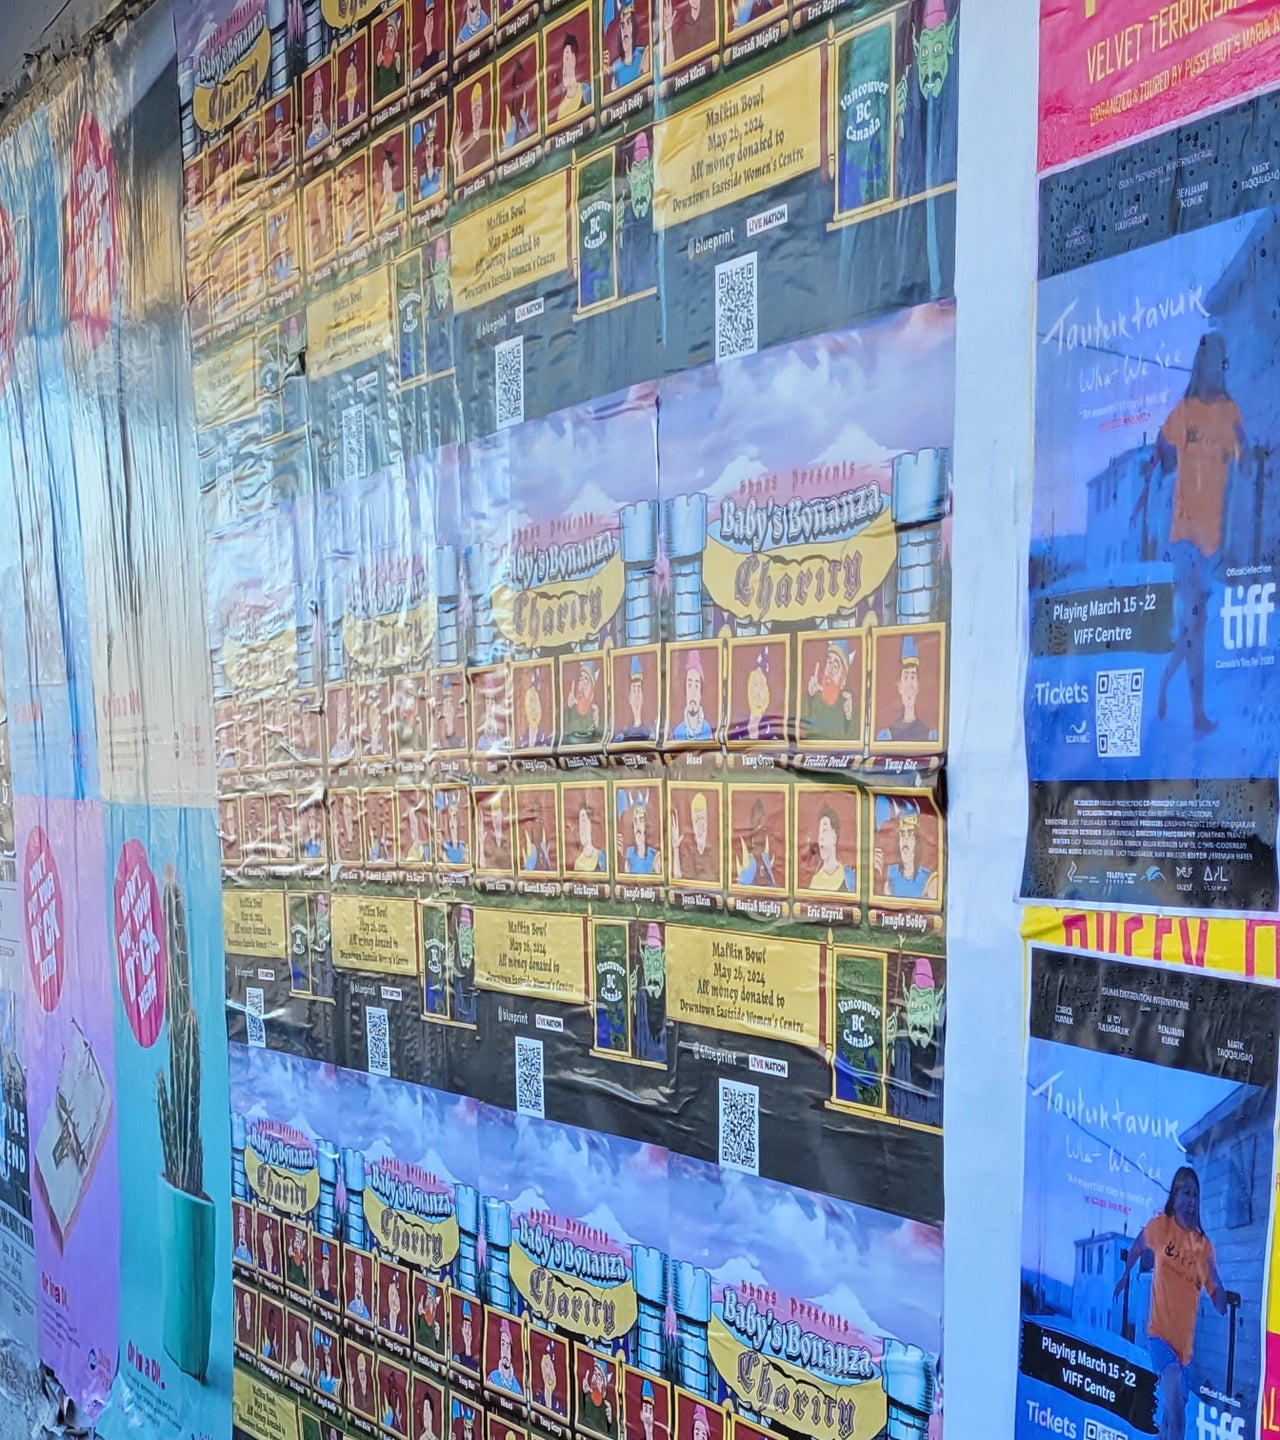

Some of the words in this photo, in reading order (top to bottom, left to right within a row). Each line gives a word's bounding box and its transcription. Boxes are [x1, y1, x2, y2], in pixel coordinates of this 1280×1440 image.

[1087, 24, 1143, 84] VELVET
[1139, 70, 1170, 102] TOURED
[1171, 67, 1183, 84] BY
[1185, 51, 1210, 77] PUSSY
[1221, 582, 1276, 650] tiff
[745, 947, 767, 964] Bowl
[713, 961, 731, 979] May
[749, 968, 766, 985] 2024
[712, 984, 739, 1003] money
[741, 988, 773, 1006] donated
[775, 992, 785, 1008] to
[837, 997, 881, 1019] Vancouver
[680, 998, 715, 1018] Downtown
[716, 1005, 744, 1022] Eastside
[746, 1010, 777, 1030] Women's
[779, 1016, 805, 1033] Centre
[851, 1015, 865, 1034] BC
[843, 1028, 874, 1049] Canada
[699, 1044, 737, 1066] blueprint
[764, 1059, 786, 1074] NATION
[723, 1287, 781, 1350] Baby's
[786, 1320, 872, 1378] Bonanza
[737, 1350, 856, 1440] Charity
[1027, 1400, 1077, 1440] Tickets
